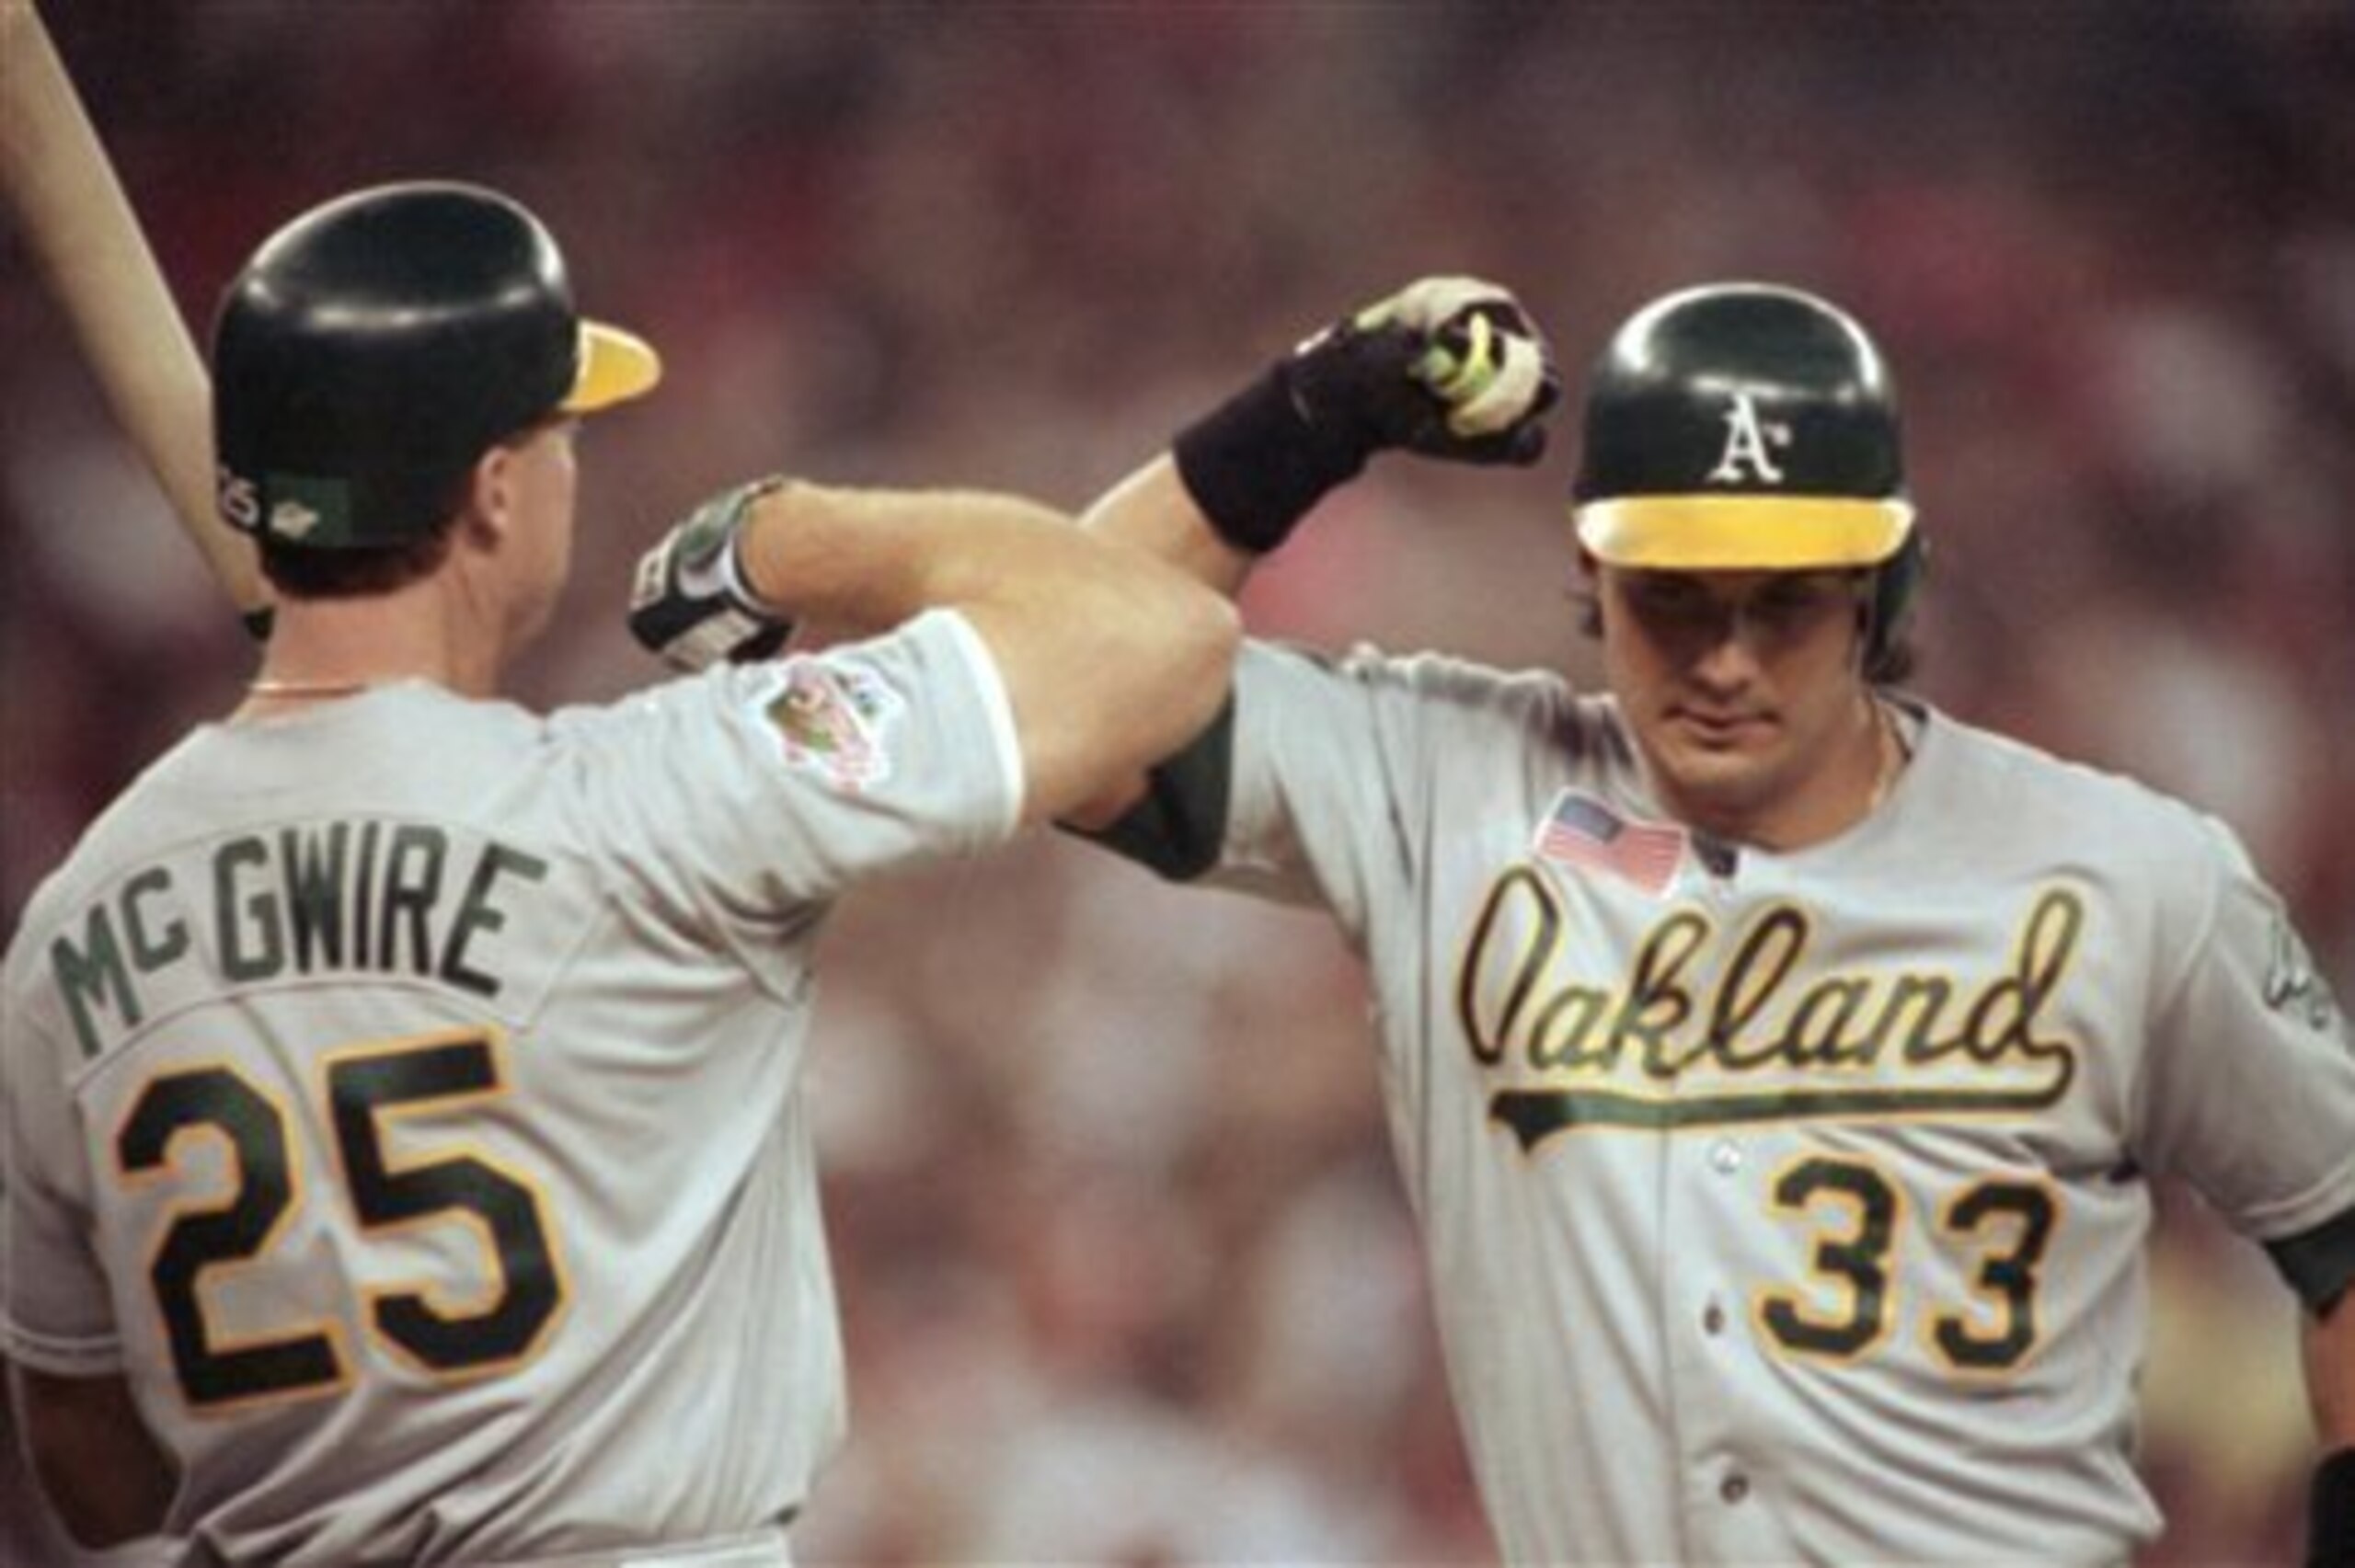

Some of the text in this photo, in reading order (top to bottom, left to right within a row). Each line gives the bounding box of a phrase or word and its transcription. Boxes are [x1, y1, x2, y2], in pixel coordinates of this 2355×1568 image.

[1457, 864, 2084, 1122] Oakland
[115, 1028, 569, 1419] 25
[1756, 1153, 2061, 1372] 33
